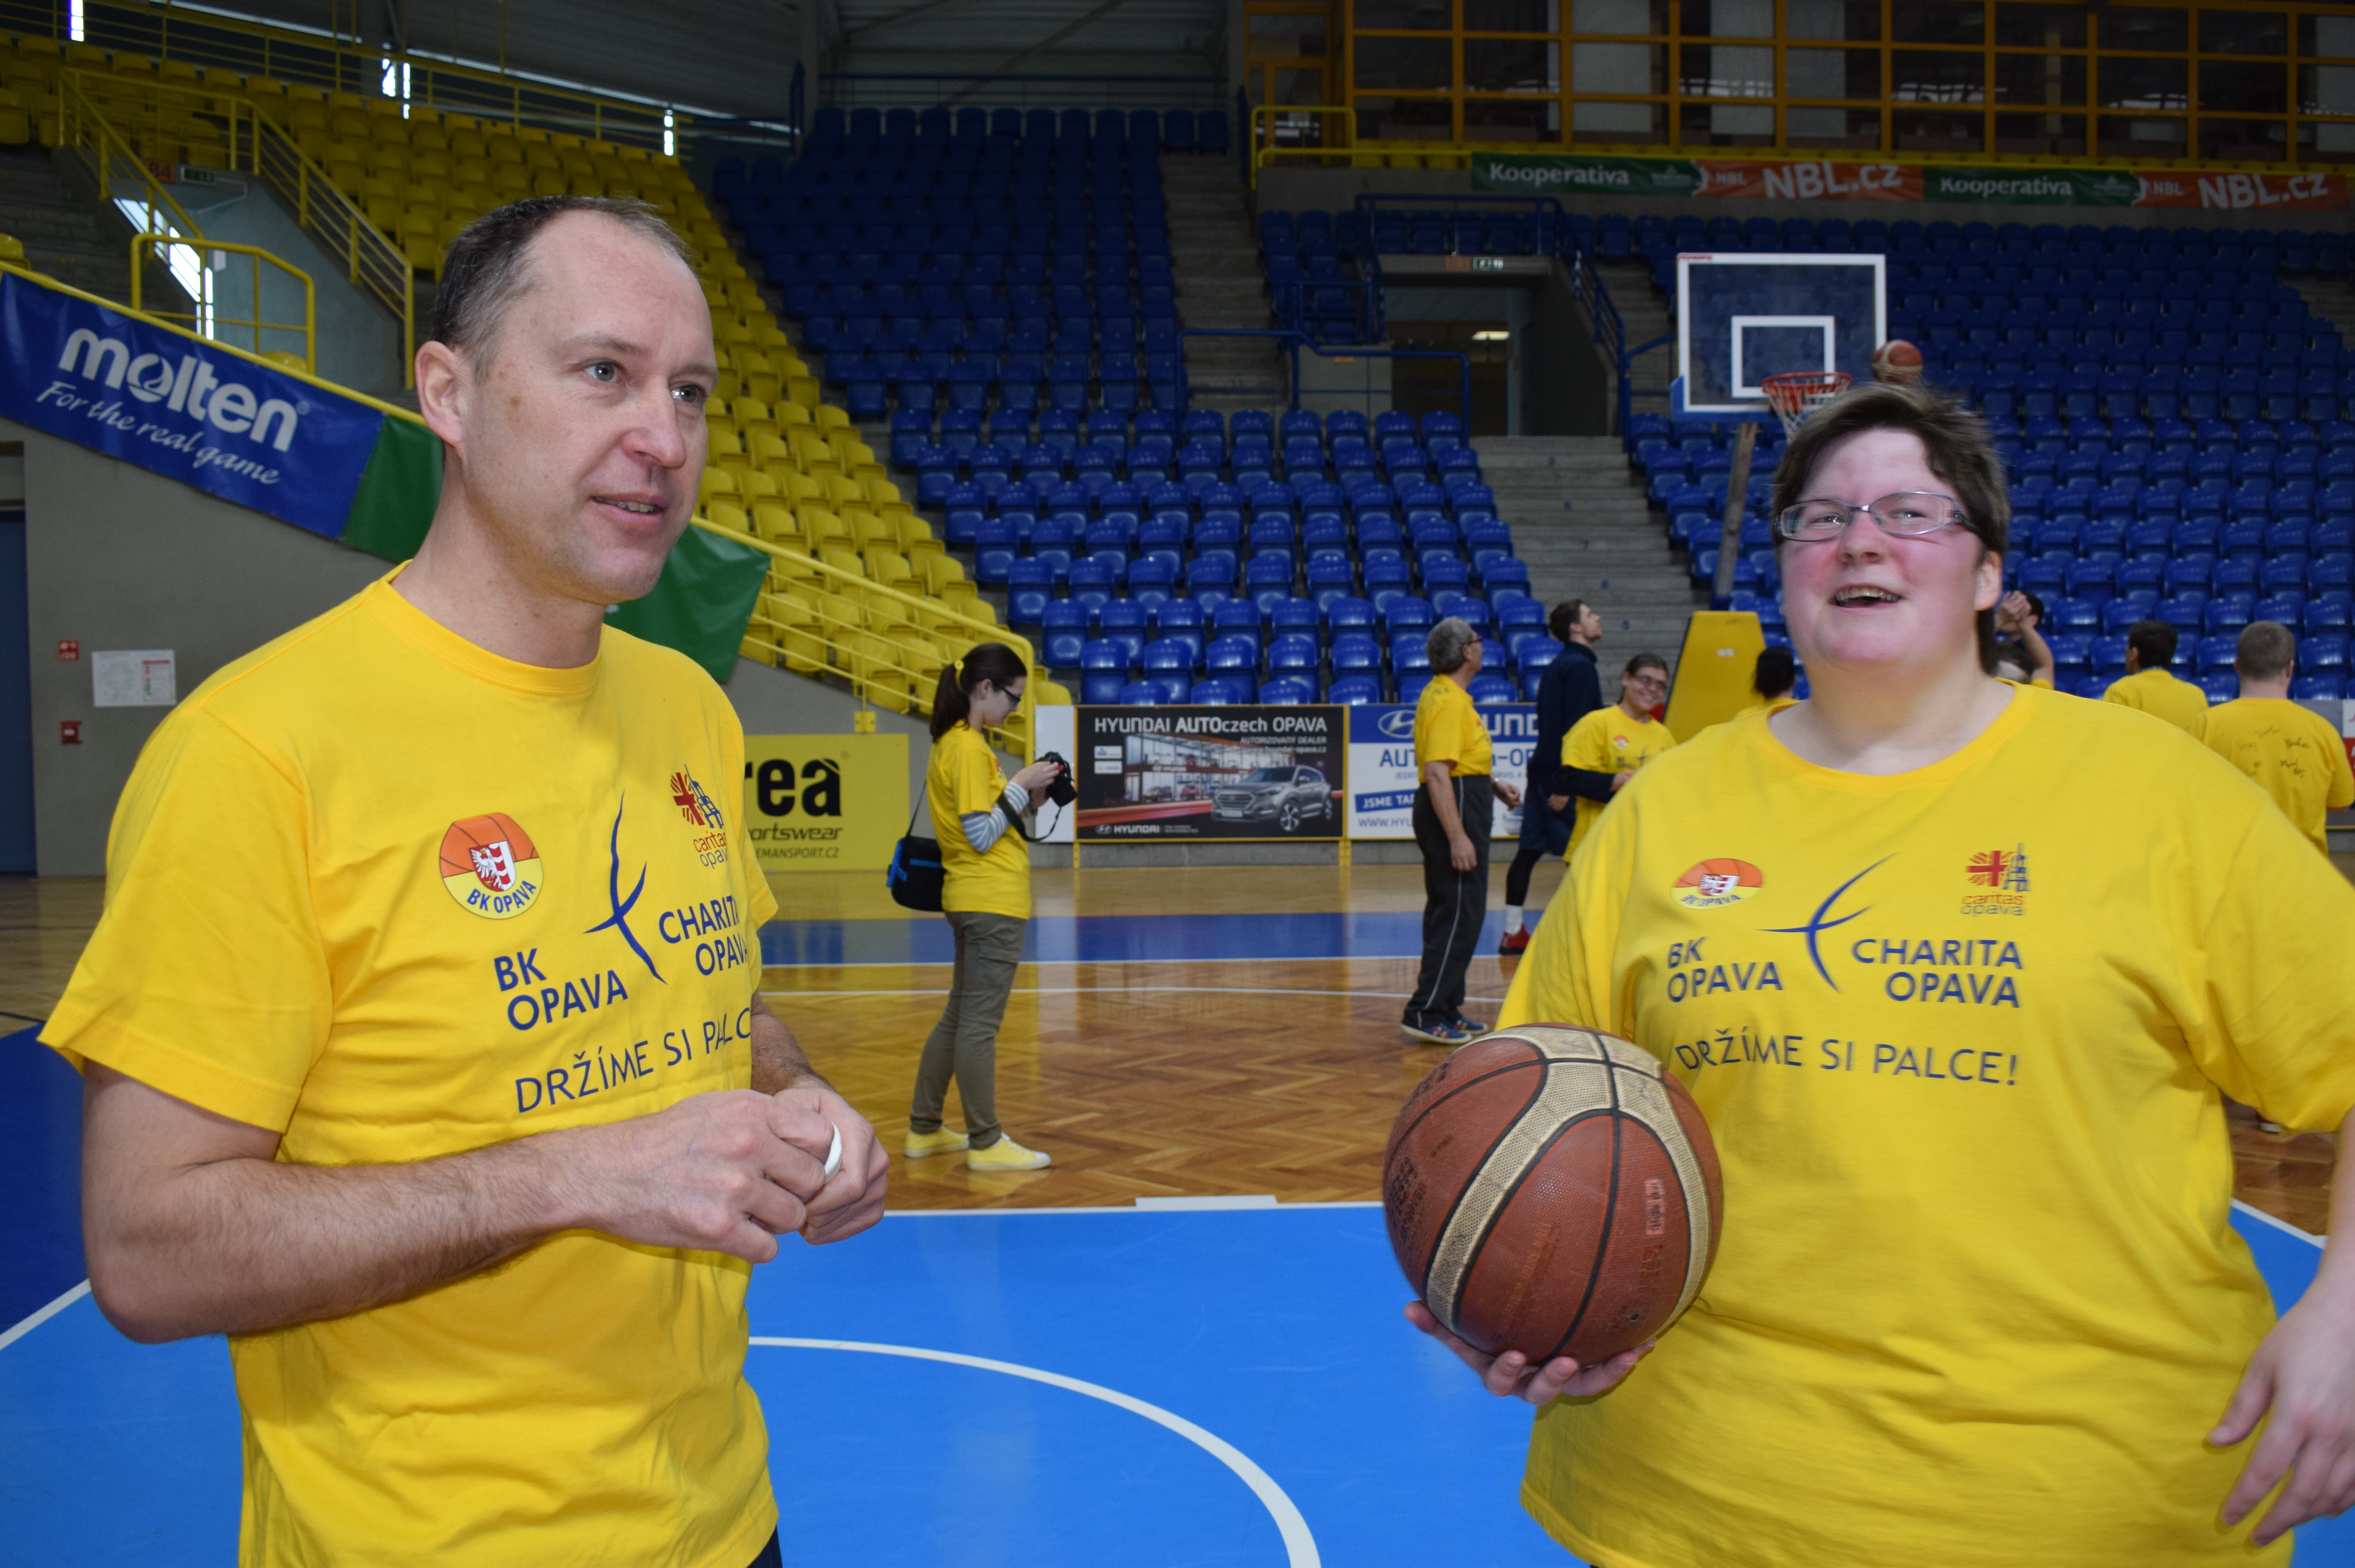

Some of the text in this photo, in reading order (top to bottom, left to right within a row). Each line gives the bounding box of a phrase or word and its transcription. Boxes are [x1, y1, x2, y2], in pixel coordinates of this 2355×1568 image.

[1490, 163, 1630, 186] Kooperativa
[1940, 177, 2072, 199] Kooperativa
[58, 328, 298, 452] molten
[37, 381, 280, 485] For the real game
[1095, 717, 1327, 733] HYUNDAI AUTOczech OPAVA
[1297, 736, 1327, 744] DEALER
[1362, 795, 1393, 809] JSME
[748, 822, 843, 841] ortswear
[1114, 824, 1160, 834] HYUNDAI
[756, 847, 840, 859] EMANSPORT.CZ
[467, 880, 537, 913] BK OPAVA
[1960, 904, 2025, 917] opava
[1962, 891, 2025, 905] caritas
[1668, 935, 1707, 968] BK
[1851, 938, 2024, 970] CHARITA
[493, 947, 547, 992] BK
[1667, 962, 1783, 1003] OPAVA
[507, 969, 628, 1030] OPAVA
[1886, 971, 2020, 1008] OPAVA
[515, 1007, 750, 1113] DRŽÍME SI PALC
[1674, 1026, 2017, 1086] DRŽÍME SI PALCE!
